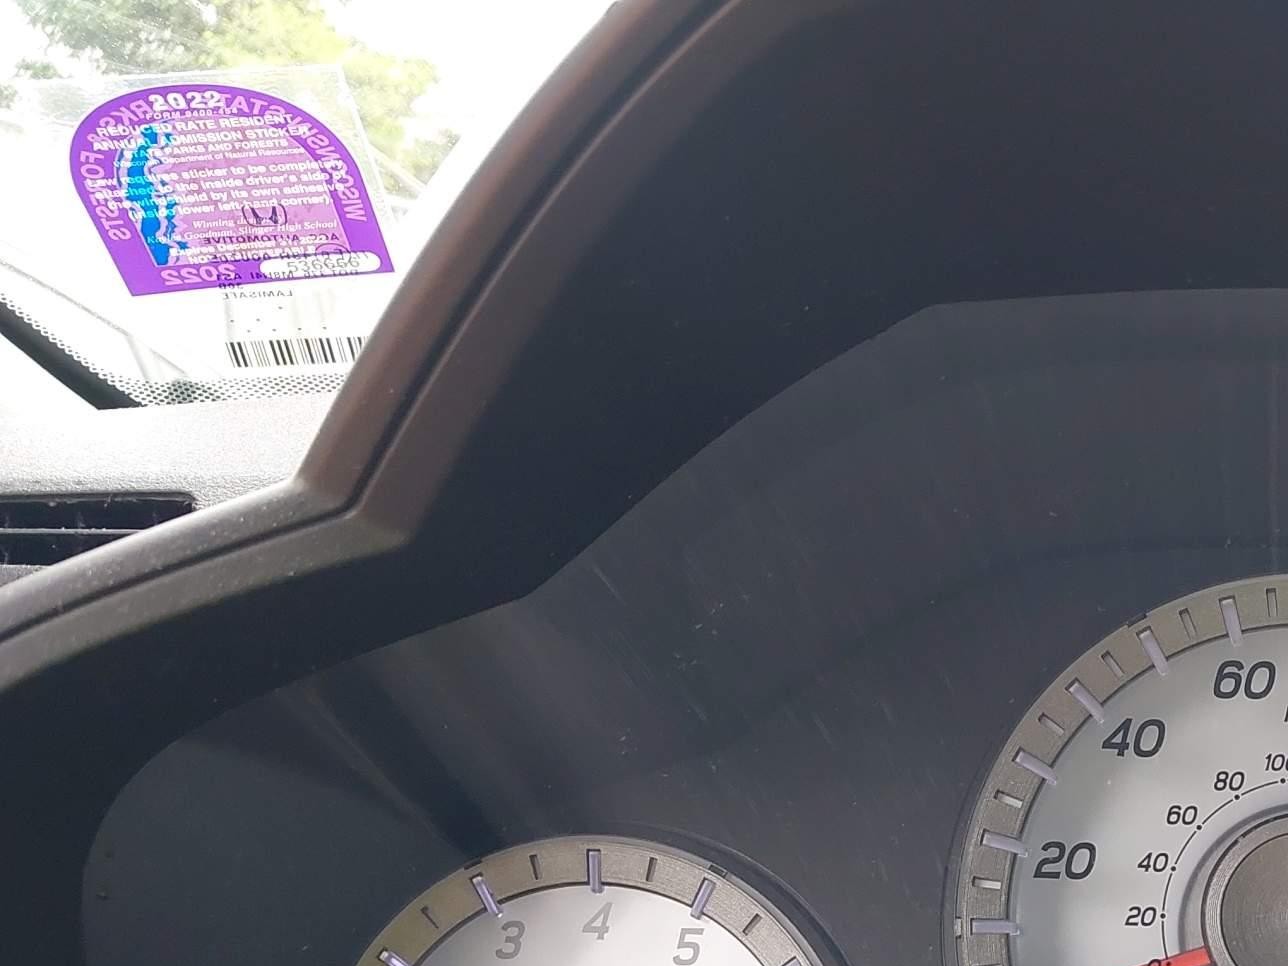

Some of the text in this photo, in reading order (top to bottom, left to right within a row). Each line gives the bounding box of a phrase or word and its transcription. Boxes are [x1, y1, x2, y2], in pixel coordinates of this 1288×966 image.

[148, 90, 224, 111] 2022
[96, 113, 292, 138] REDUCED RATE RESIDENT
[145, 110, 181, 121] FORM
[160, 130, 243, 146] ADMISSION
[165, 144, 204, 156] PARKS
[207, 143, 232, 153] AND
[235, 139, 288, 151] FORESTS
[182, 168, 228, 179] sticker
[230, 166, 244, 175] to
[249, 164, 266, 174] be
[159, 184, 173, 195] to
[176, 181, 198, 192] the
[202, 178, 242, 190] inside
[212, 191, 227, 202] by
[231, 188, 248, 198] its
[251, 186, 280, 197] own
[178, 203, 215, 216] lower
[192, 218, 234, 229] Winning
[304, 219, 337, 230] School
[1213, 660, 1277, 700] 60
[1102, 718, 1166, 757] 40
[1213, 771, 1245, 792] 80
[1166, 806, 1198, 826] 60
[1033, 841, 1096, 880] 20
[1137, 853, 1170, 873] 40
[583, 903, 613, 940] 4
[1125, 907, 1157, 927] 20
[495, 921, 525, 959] 3
[673, 928, 704, 965] 5
